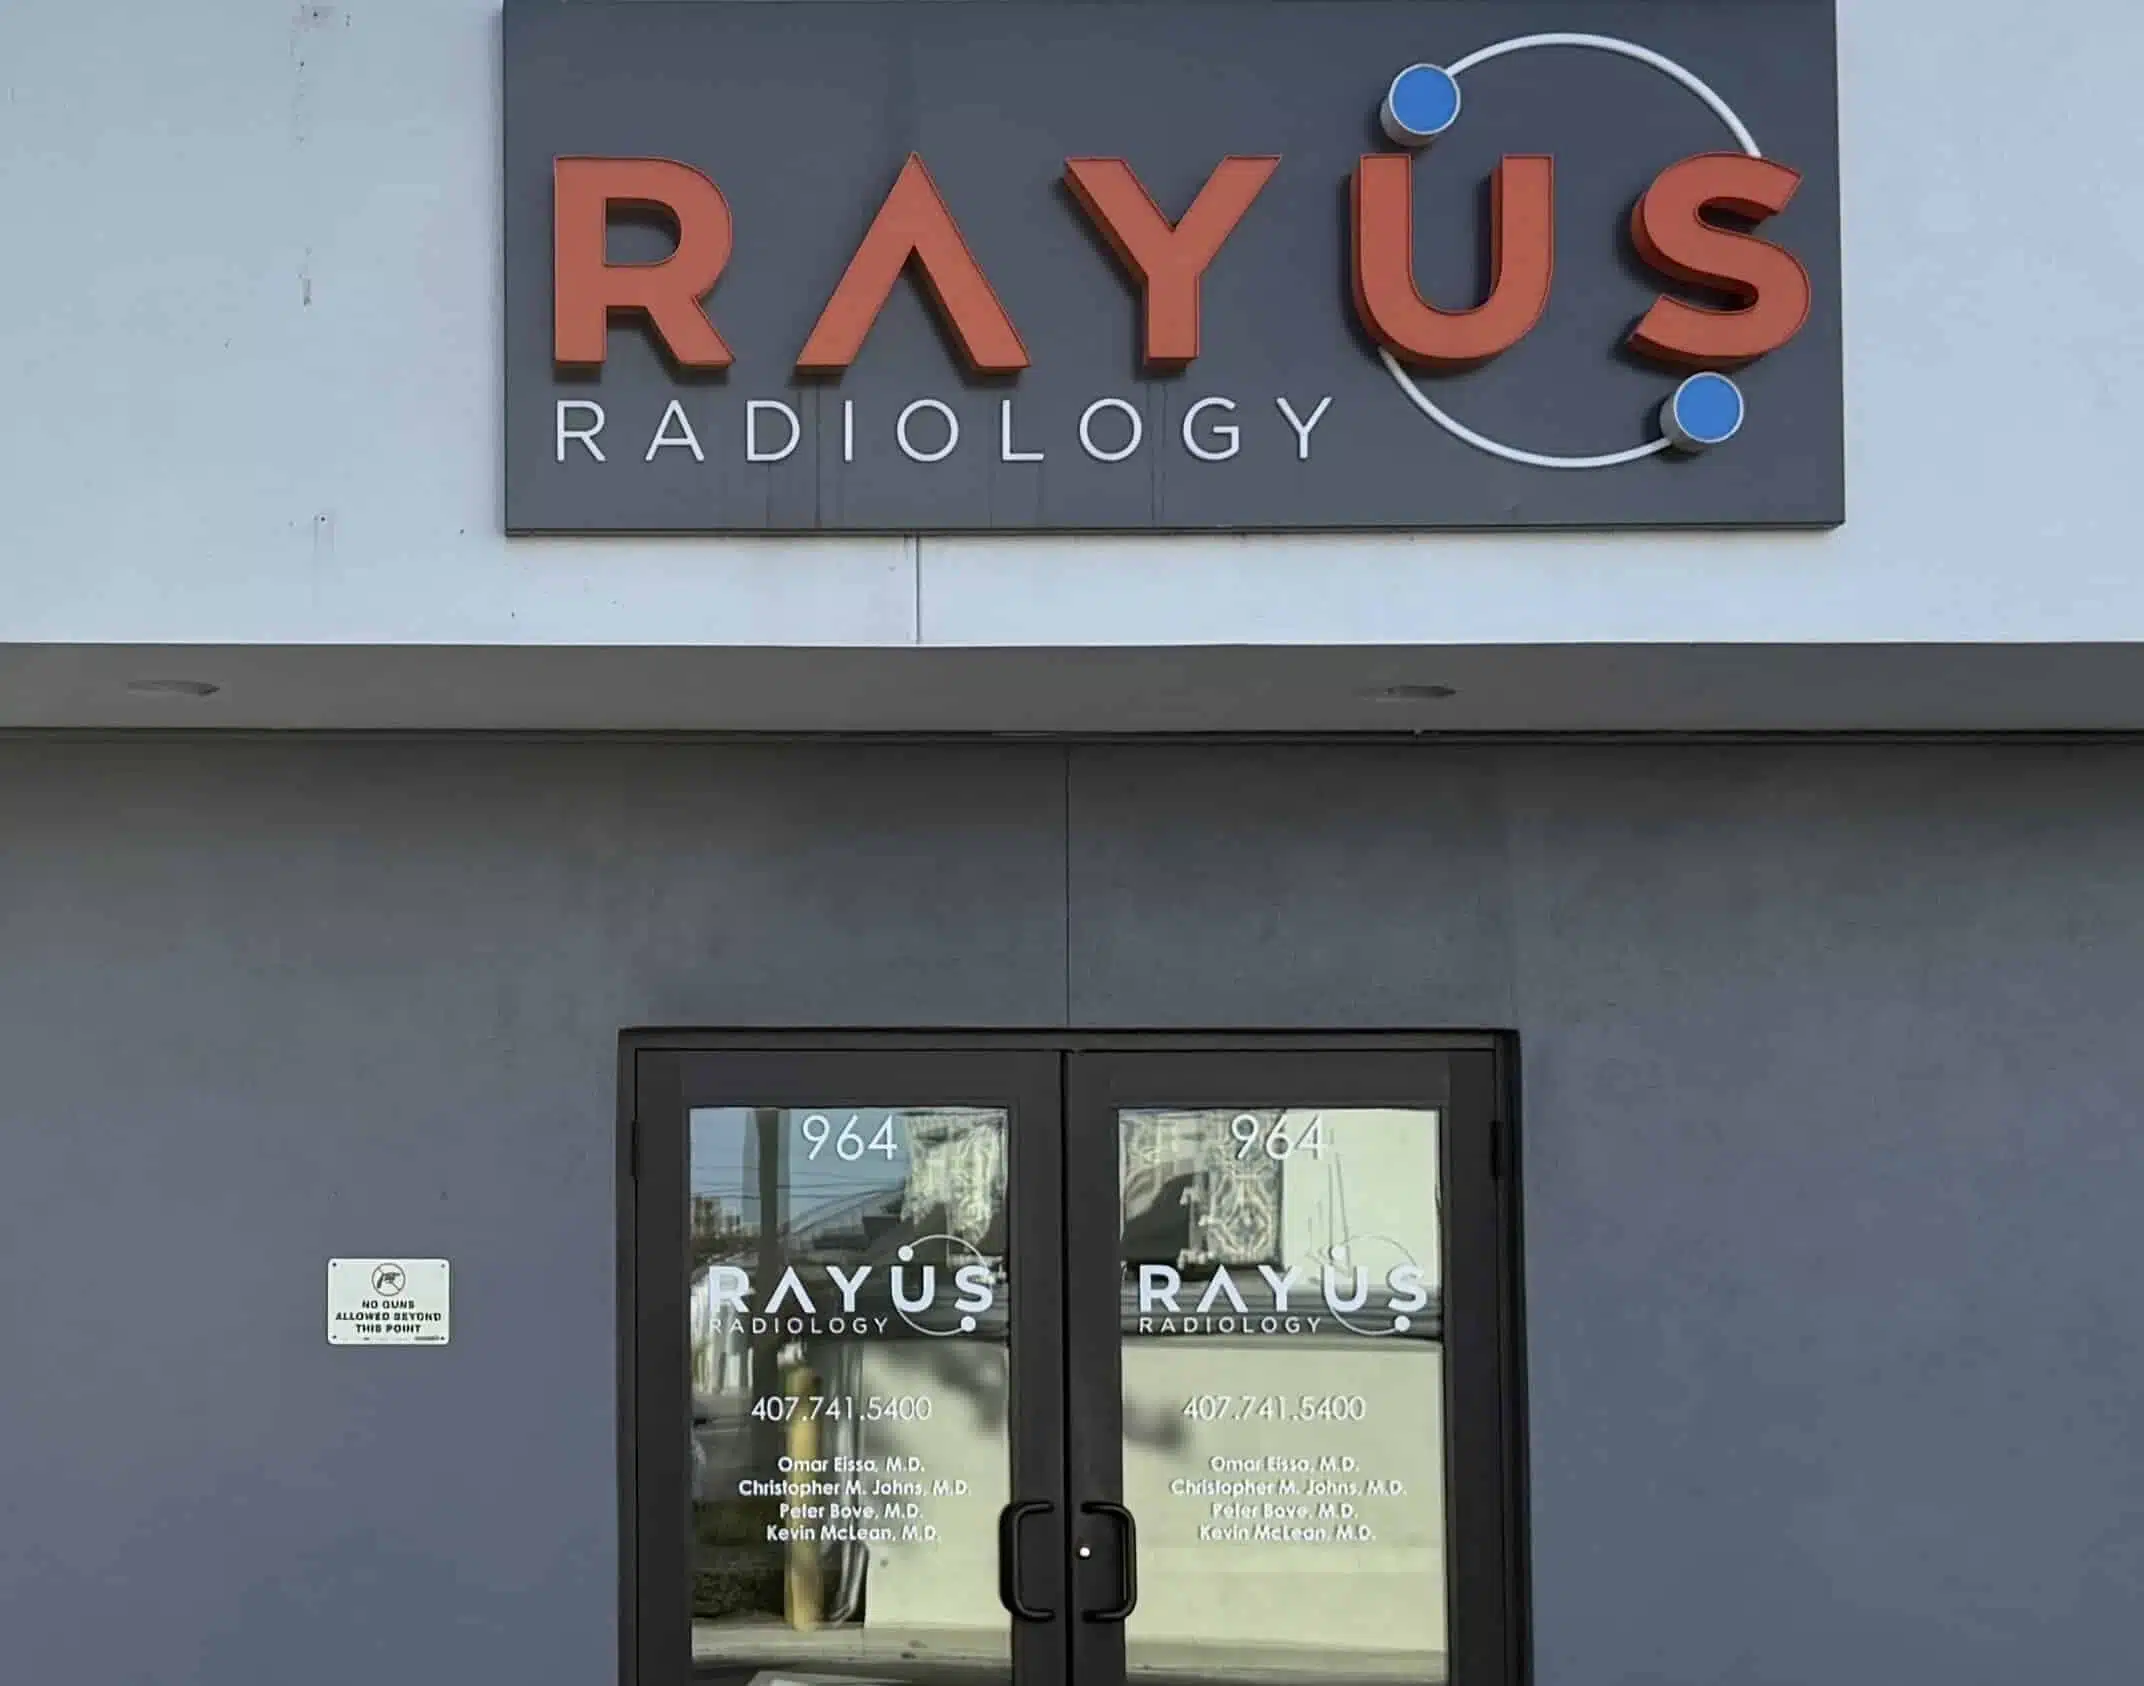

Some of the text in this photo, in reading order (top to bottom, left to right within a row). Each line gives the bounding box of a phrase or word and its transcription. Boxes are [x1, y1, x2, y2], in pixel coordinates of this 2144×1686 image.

[553, 151, 1811, 374] RAYUS
[555, 396, 1333, 464] RADIOLOGY
[802, 1113, 898, 1161] 964
[1230, 1112, 1326, 1161] 964
[708, 1265, 994, 1314] RAYUS
[1138, 1264, 1429, 1313] RAYUS
[362, 1300, 415, 1309] NO GUNS
[335, 1312, 442, 1322] ALLOWED BEYOND
[710, 1317, 889, 1334] RADIOLOGY
[1139, 1316, 1322, 1334] RADIOLOGY
[356, 1324, 422, 1333] THIS POINT
[751, 1396, 932, 1421] 407.741.5400
[1182, 1395, 1367, 1421] 407.741.5400
[777, 1456, 925, 1474] Omar Eissa, M.D.
[1210, 1456, 1264, 1473] Omar
[1319, 1456, 1360, 1473] M.D.
[738, 1480, 972, 1498] Christopher M. Johns, M.D.
[1170, 1479, 1407, 1498] Christopher M. Johns, M.D.
[780, 1504, 824, 1519] Peter
[884, 1504, 924, 1519] M.D.
[1212, 1503, 1258, 1519] Peter
[1316, 1504, 1358, 1519] M.D.
[767, 1525, 942, 1543] Kevin McLean, M.D.
[1198, 1524, 1249, 1541] Kevin
[1335, 1525, 1376, 1541] M.D.
